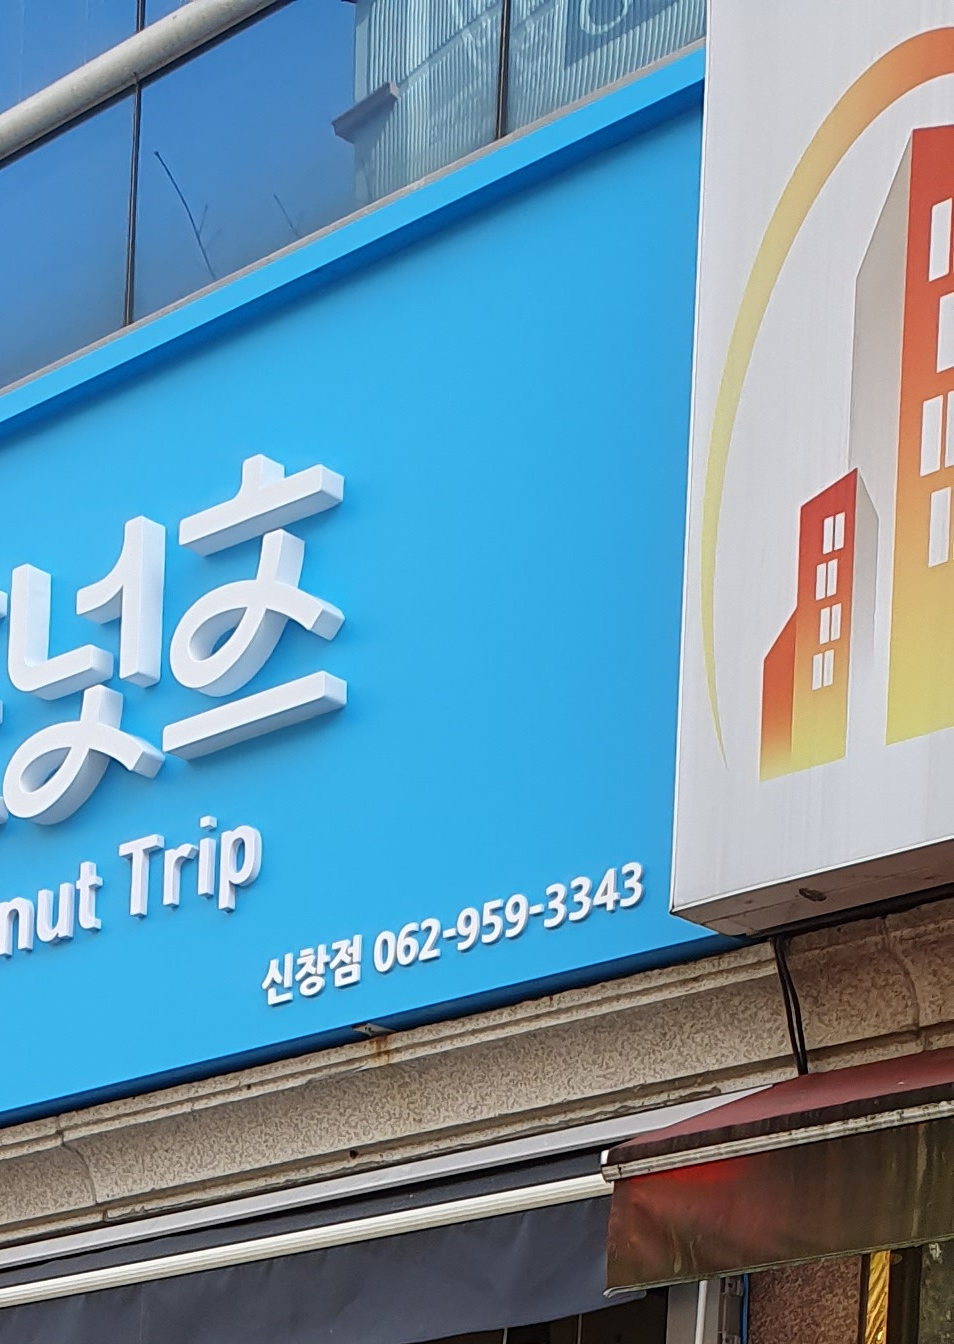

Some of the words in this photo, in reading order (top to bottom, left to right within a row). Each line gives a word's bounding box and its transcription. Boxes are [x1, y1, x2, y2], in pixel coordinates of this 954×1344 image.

[118, 814, 263, 920] Trip
[261, 933, 363, 1006] 신창점
[372, 862, 645, 975] 062-959-3343
